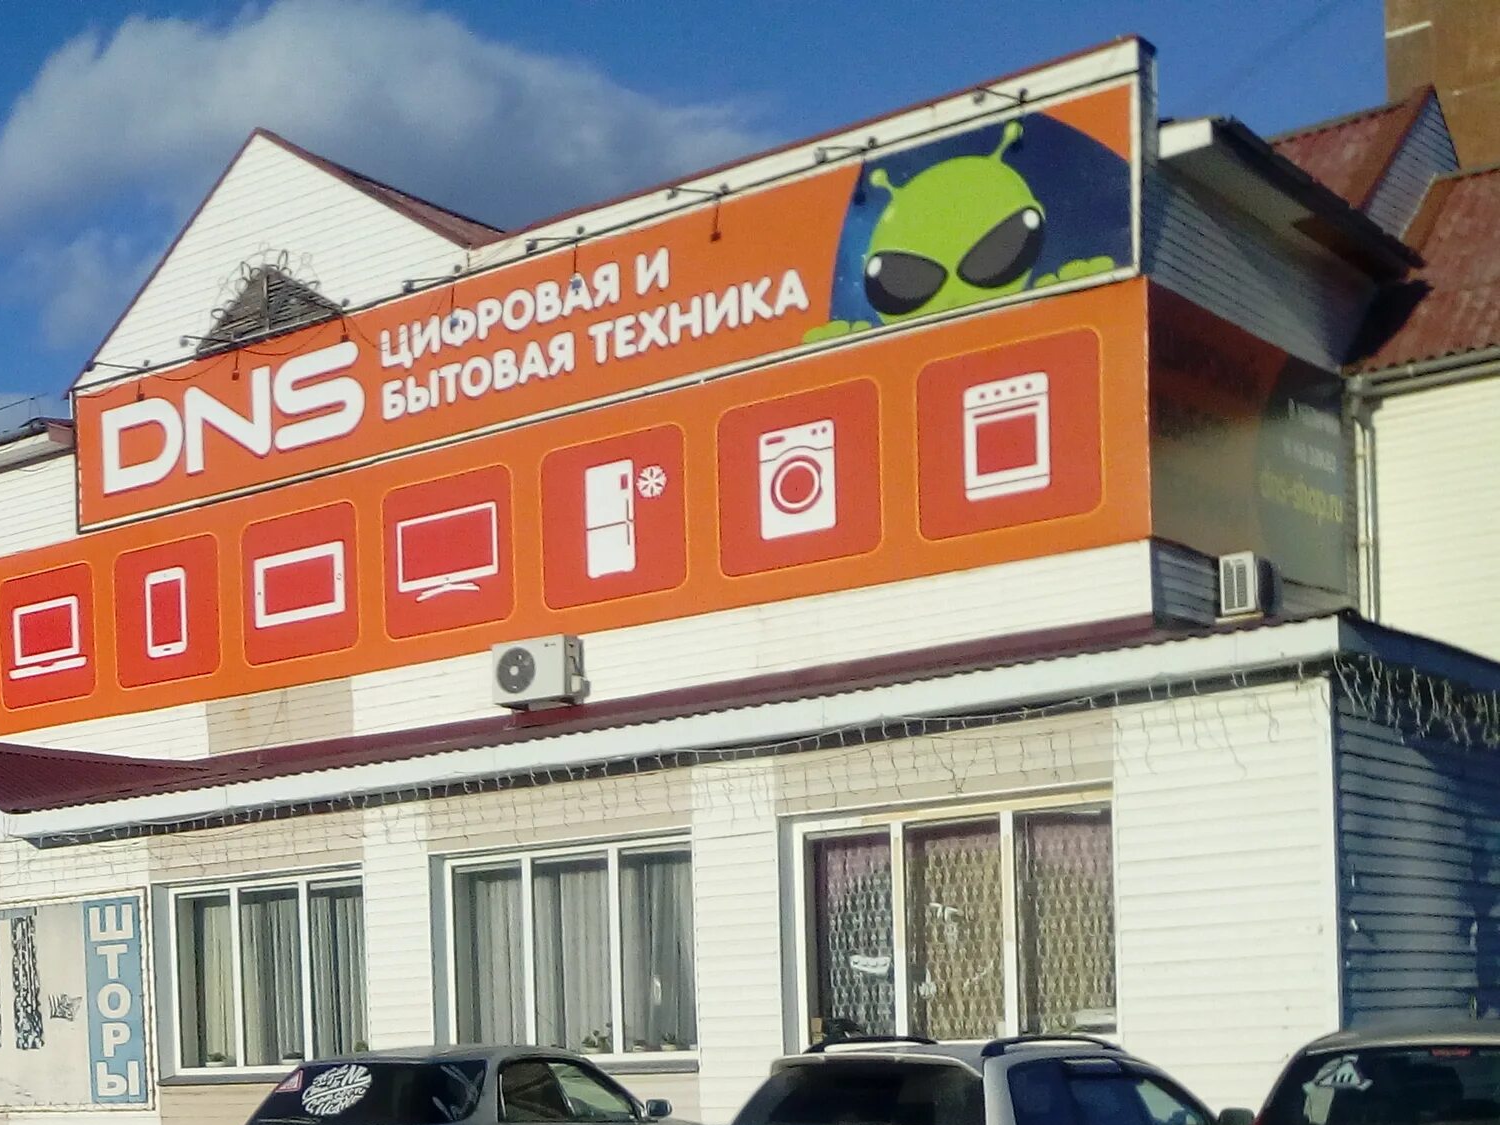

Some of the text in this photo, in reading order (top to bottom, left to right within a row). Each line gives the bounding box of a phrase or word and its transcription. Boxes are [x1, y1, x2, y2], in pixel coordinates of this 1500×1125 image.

[381, 248, 671, 368] ЦИФРОВАЯ И
[381, 268, 810, 421] БЫТОВАЯ ТЕХНИКА
[101, 341, 366, 494] DNS
[88, 903, 140, 1098] ШТОРЫ
